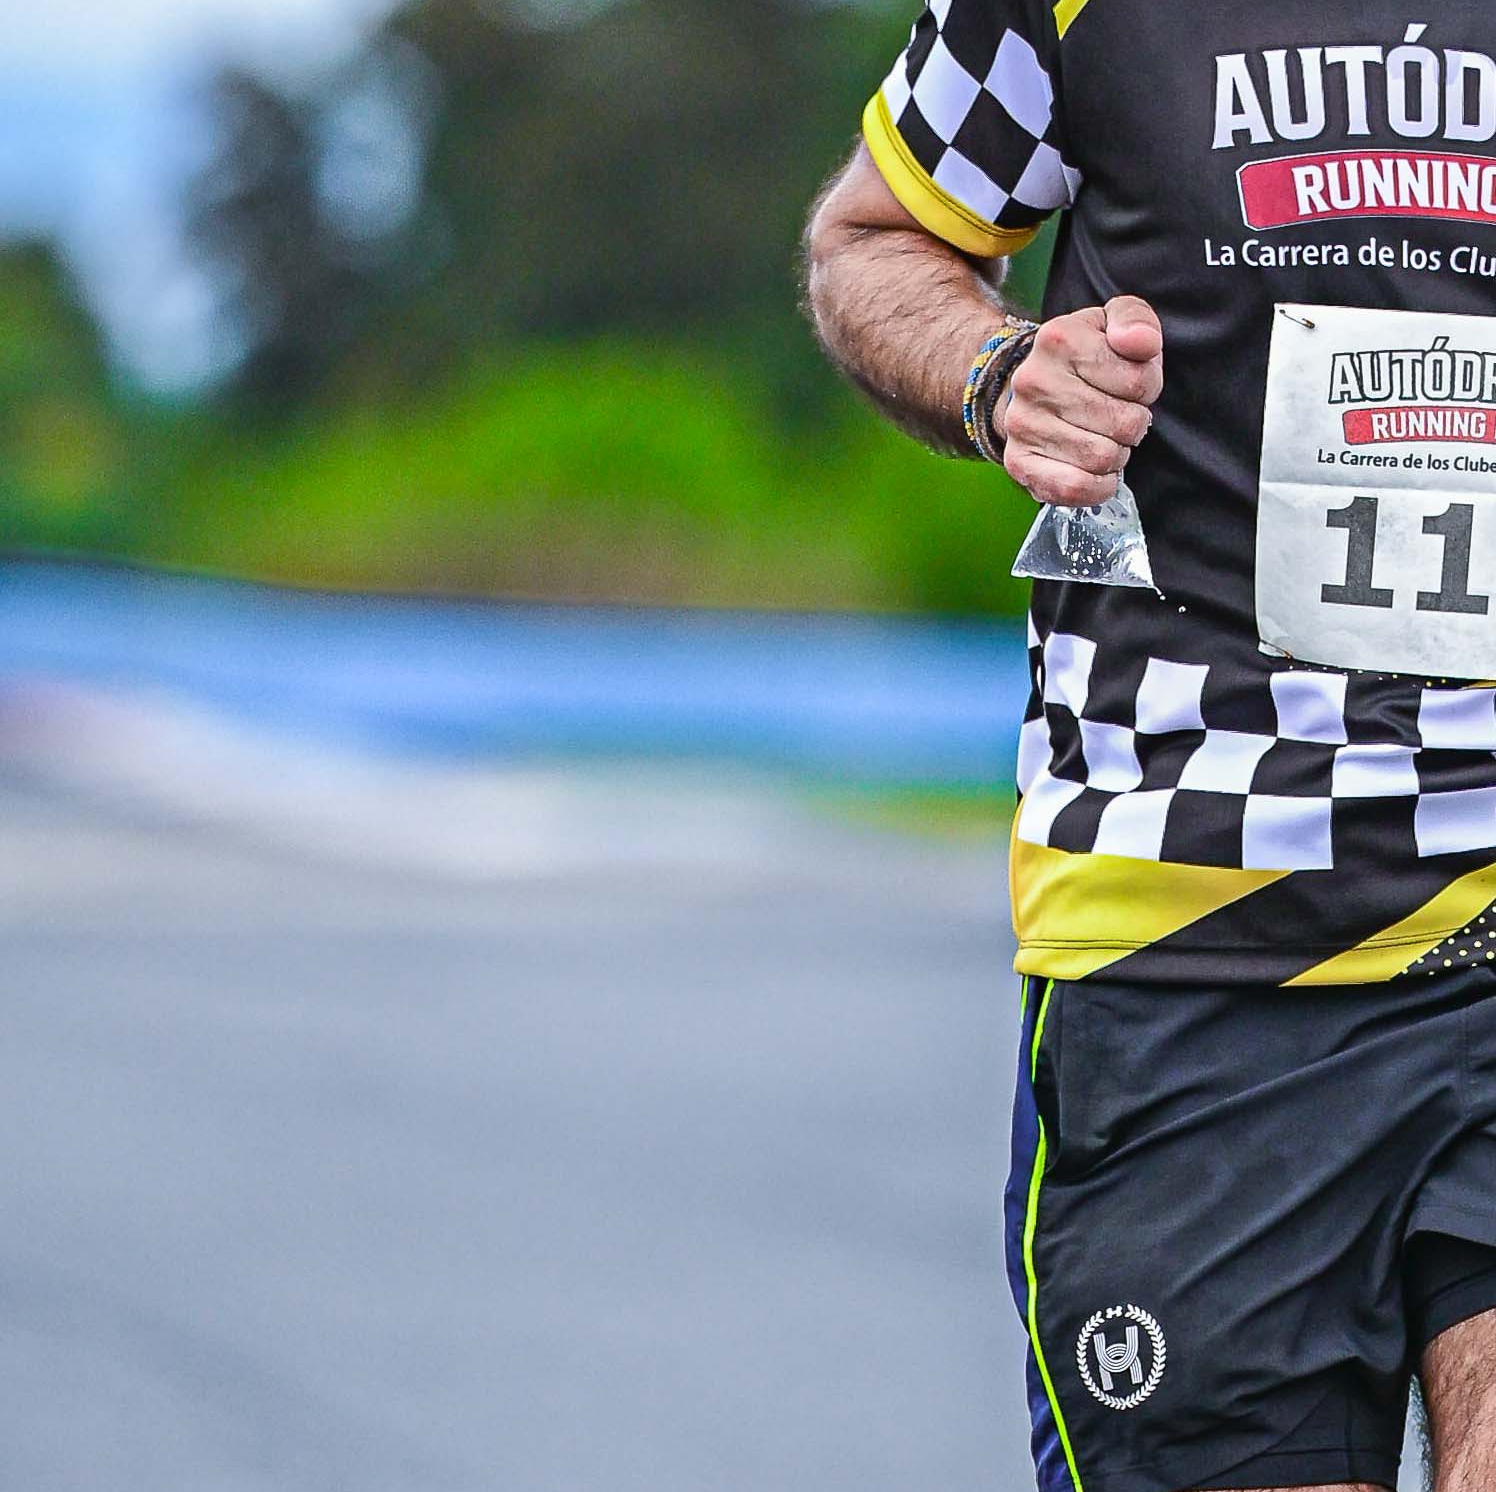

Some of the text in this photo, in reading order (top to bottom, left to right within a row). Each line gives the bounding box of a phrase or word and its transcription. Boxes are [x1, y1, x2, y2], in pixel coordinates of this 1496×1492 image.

[1204, 239, 1236, 267] La
[1241, 239, 1350, 267] Carrera
[1357, 237, 1396, 267] de
[1401, 239, 1441, 271] los
[1371, 411, 1487, 440] RUNNING
[1317, 448, 1336, 464] La
[1339, 450, 1399, 468] Carrera
[1402, 453, 1423, 469] de
[1427, 453, 1450, 471] los
